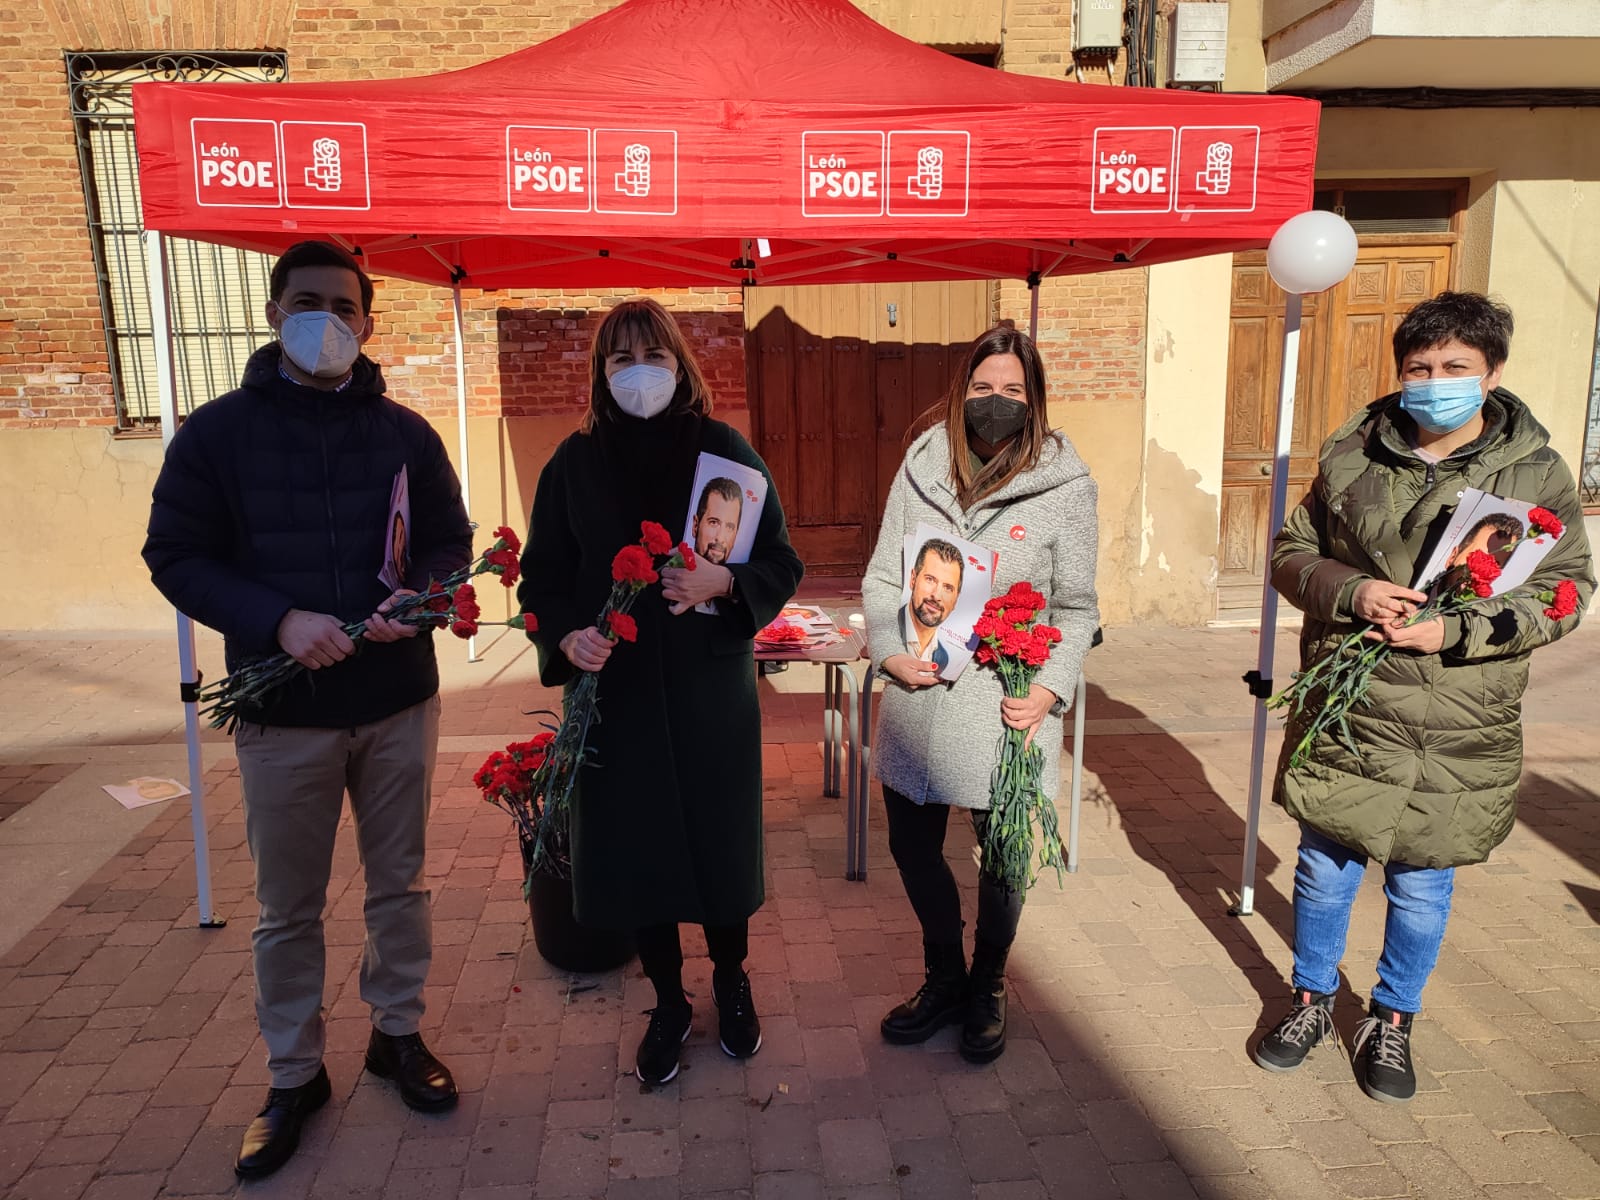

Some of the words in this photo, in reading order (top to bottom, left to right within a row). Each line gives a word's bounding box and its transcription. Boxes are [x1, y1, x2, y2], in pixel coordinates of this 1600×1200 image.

[201, 143, 239, 157] León
[514, 148, 551, 162] León
[1100, 150, 1136, 164] León
[809, 154, 846, 168] León
[202, 160, 273, 187] PSOE
[515, 165, 584, 192] PSOE
[1099, 167, 1166, 193] PSOE
[809, 171, 878, 198] PSOE
